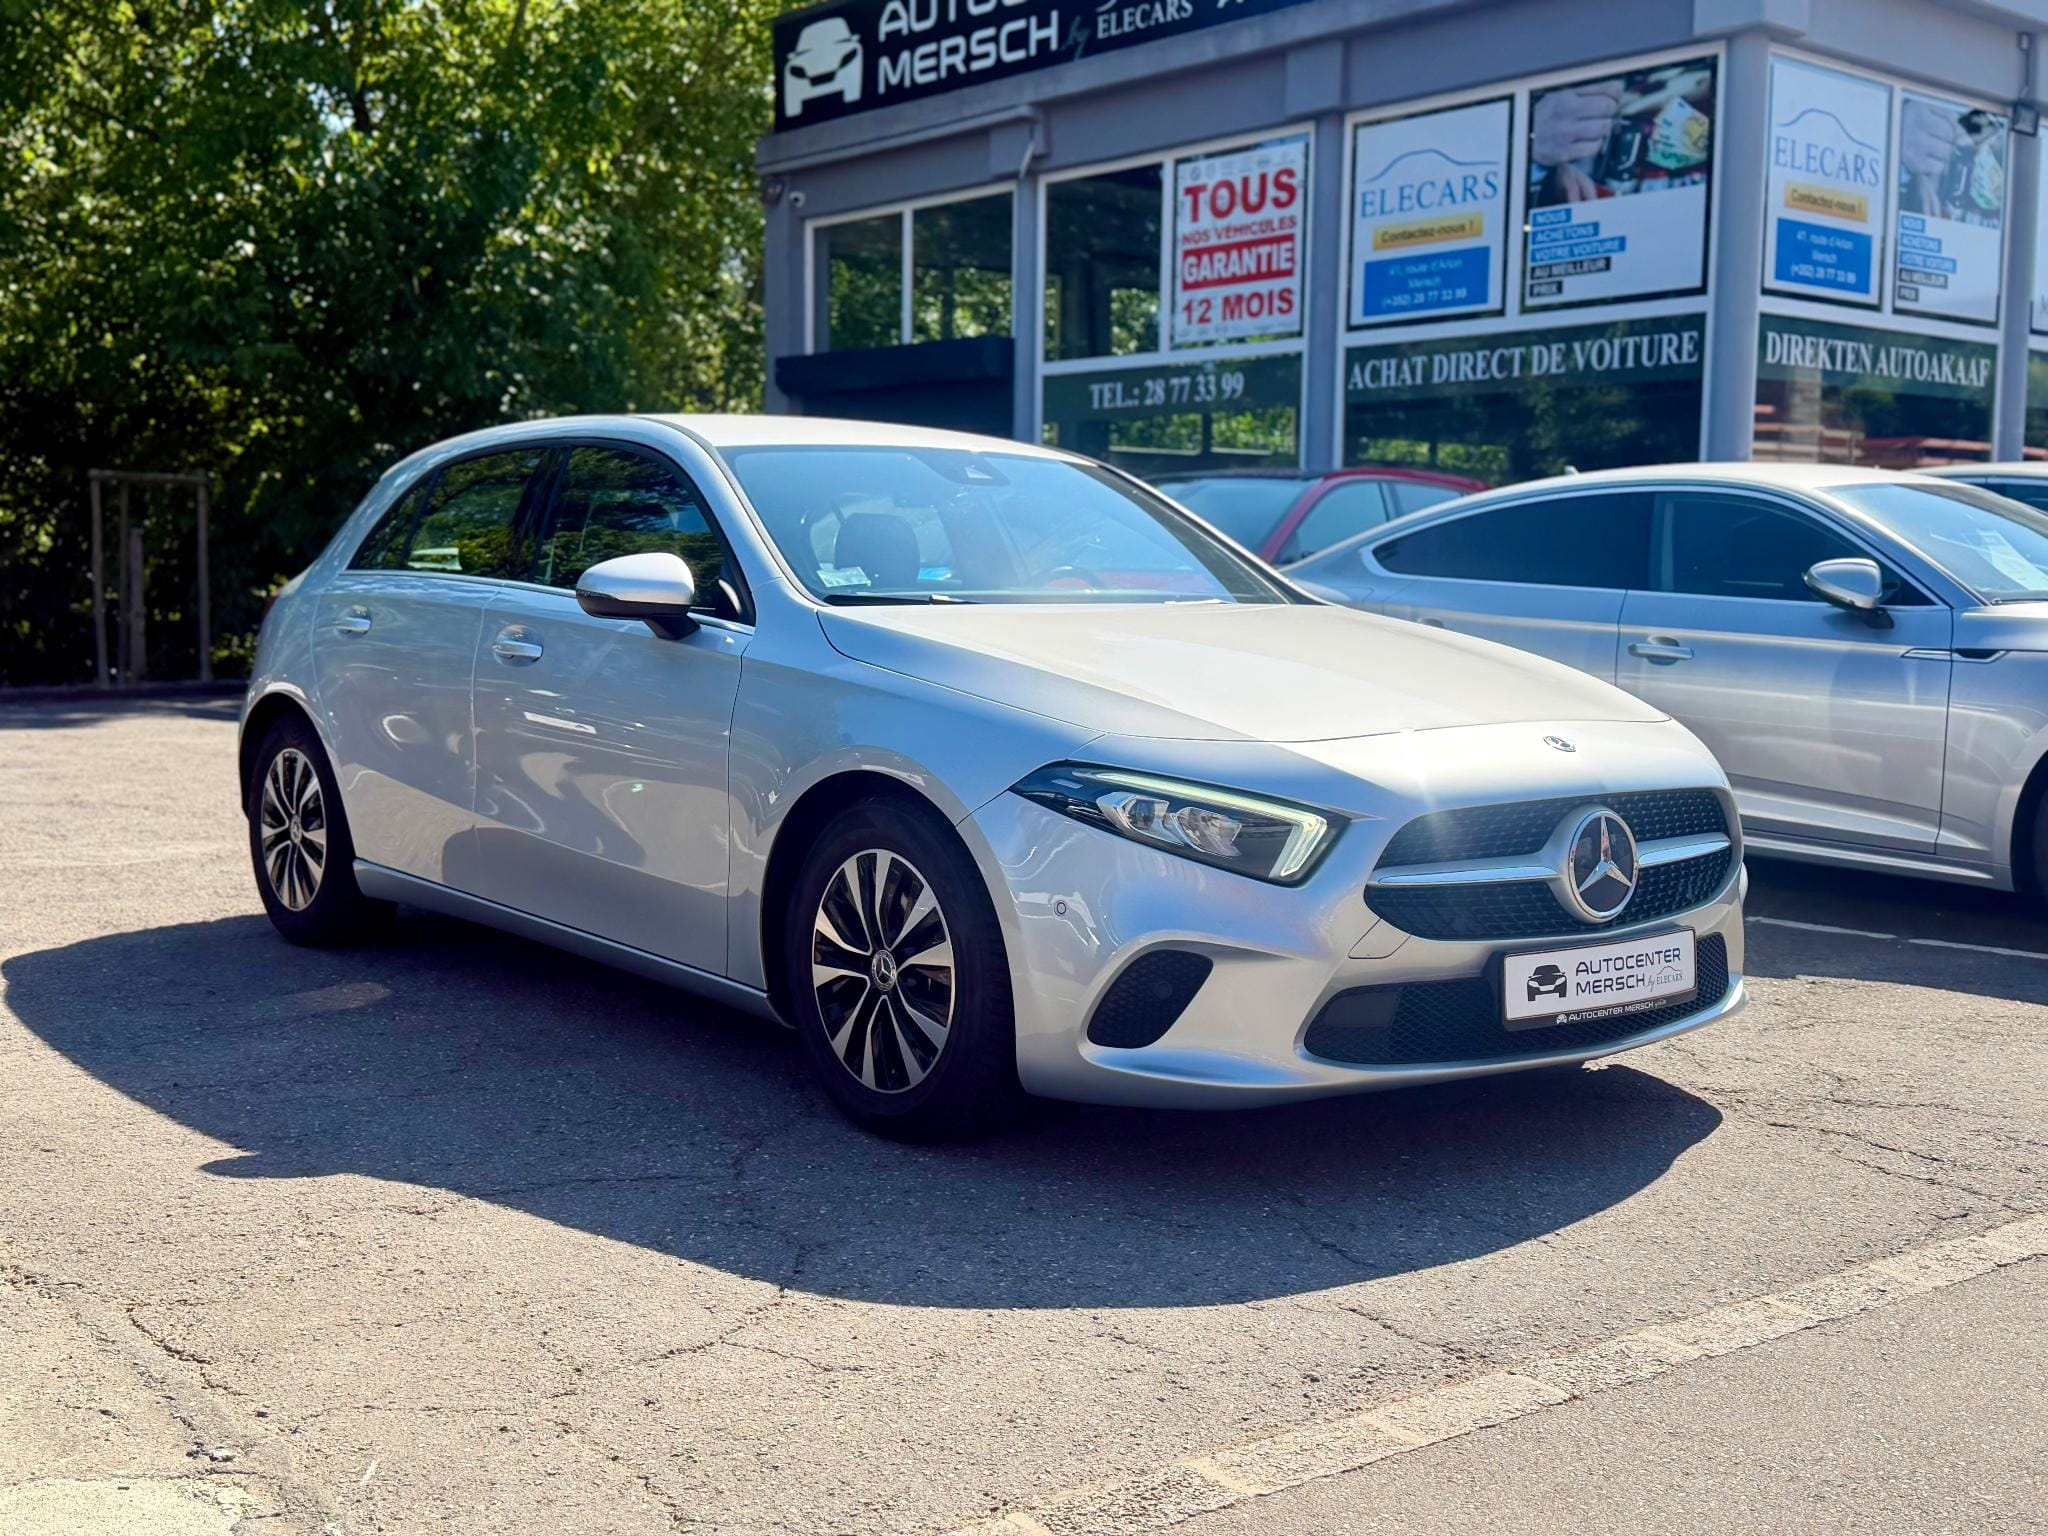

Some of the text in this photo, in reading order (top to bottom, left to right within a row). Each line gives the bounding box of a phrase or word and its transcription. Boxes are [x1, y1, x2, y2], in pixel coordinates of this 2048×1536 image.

[878, 10, 1059, 95] MERSCH
[1097, 0, 1194, 39] ELECARS
[1774, 136, 1880, 188] ELECARS
[1184, 167, 1297, 223] TOUS
[1361, 170, 1498, 218] ELECARS
[1183, 229, 1210, 245] NOS
[1183, 241, 1294, 283] GARANTIE
[1183, 287, 1295, 326] 12 MOIS
[1348, 331, 1699, 390] ACHAT DIRECT DE VOITURE
[1766, 331, 1991, 388] DIREKTEN AUTOAKAAF
[1144, 378, 1166, 406] 28
[1169, 376, 1191, 404] 77
[1194, 373, 1217, 402] 33
[1221, 371, 1245, 400] 99
[1576, 947, 1681, 976] AUTOCENTER
[1576, 973, 1683, 996] MERSCH by ELECARS
[1568, 1006, 1623, 1022] AUTOCENTER
[1624, 1001, 1654, 1012] MERSCH
